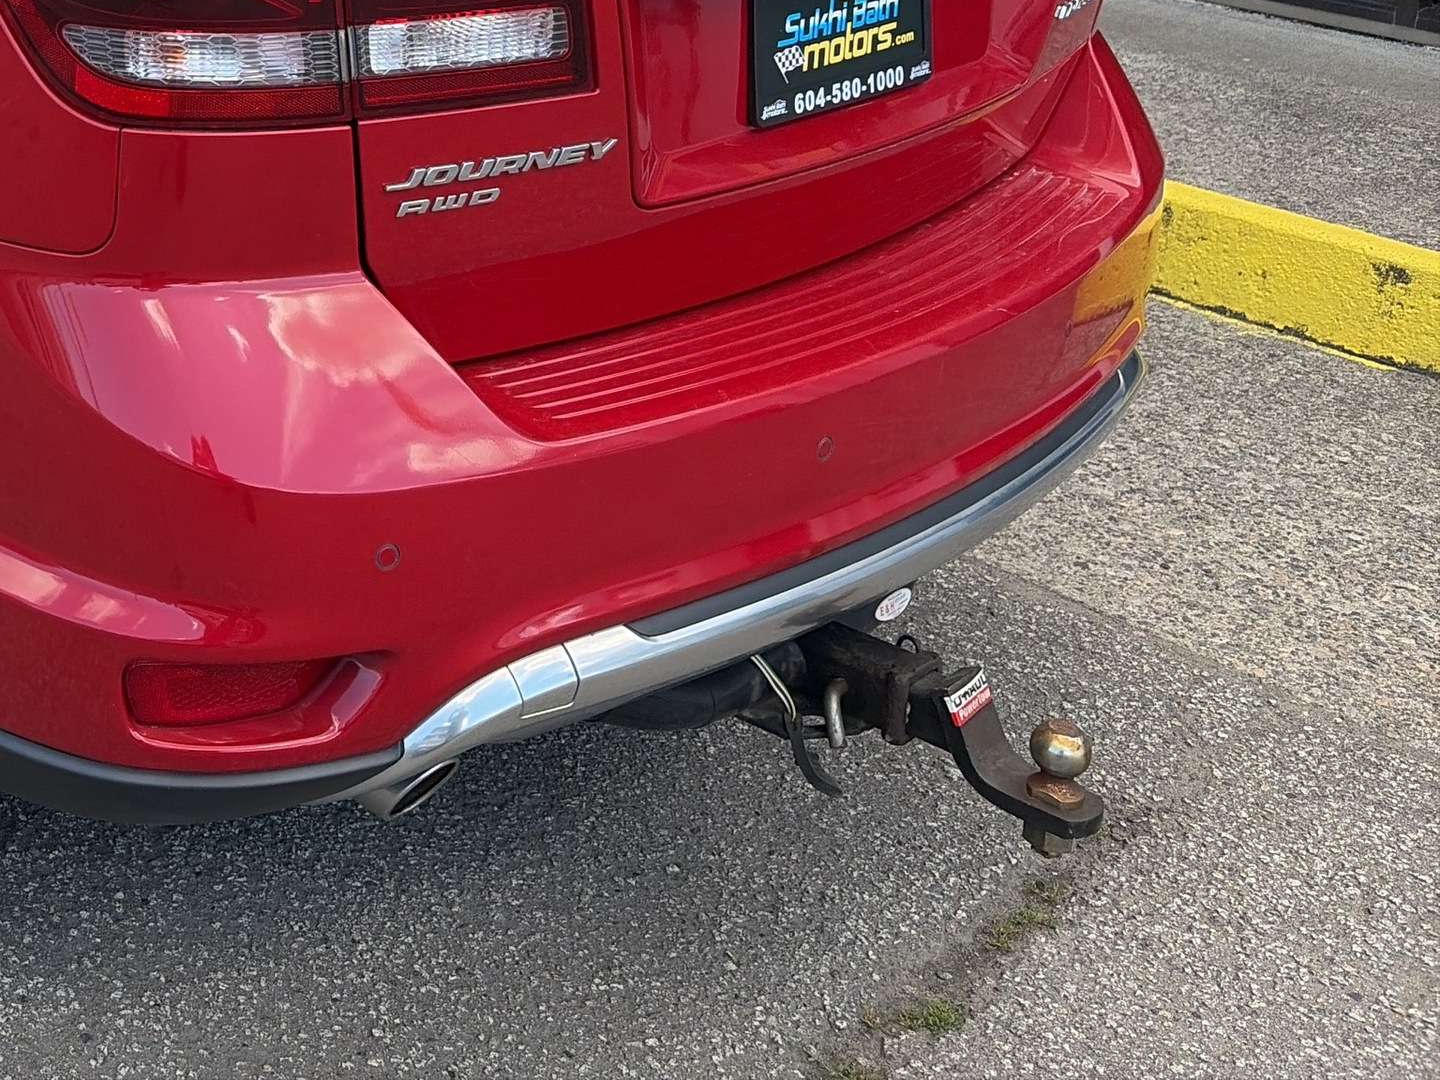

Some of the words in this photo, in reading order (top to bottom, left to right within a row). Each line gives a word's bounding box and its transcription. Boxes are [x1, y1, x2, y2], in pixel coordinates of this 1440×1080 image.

[794, 66, 904, 114] 604-580-1000
[384, 138, 618, 192] JOURNEY
[395, 187, 500, 218] AWD
